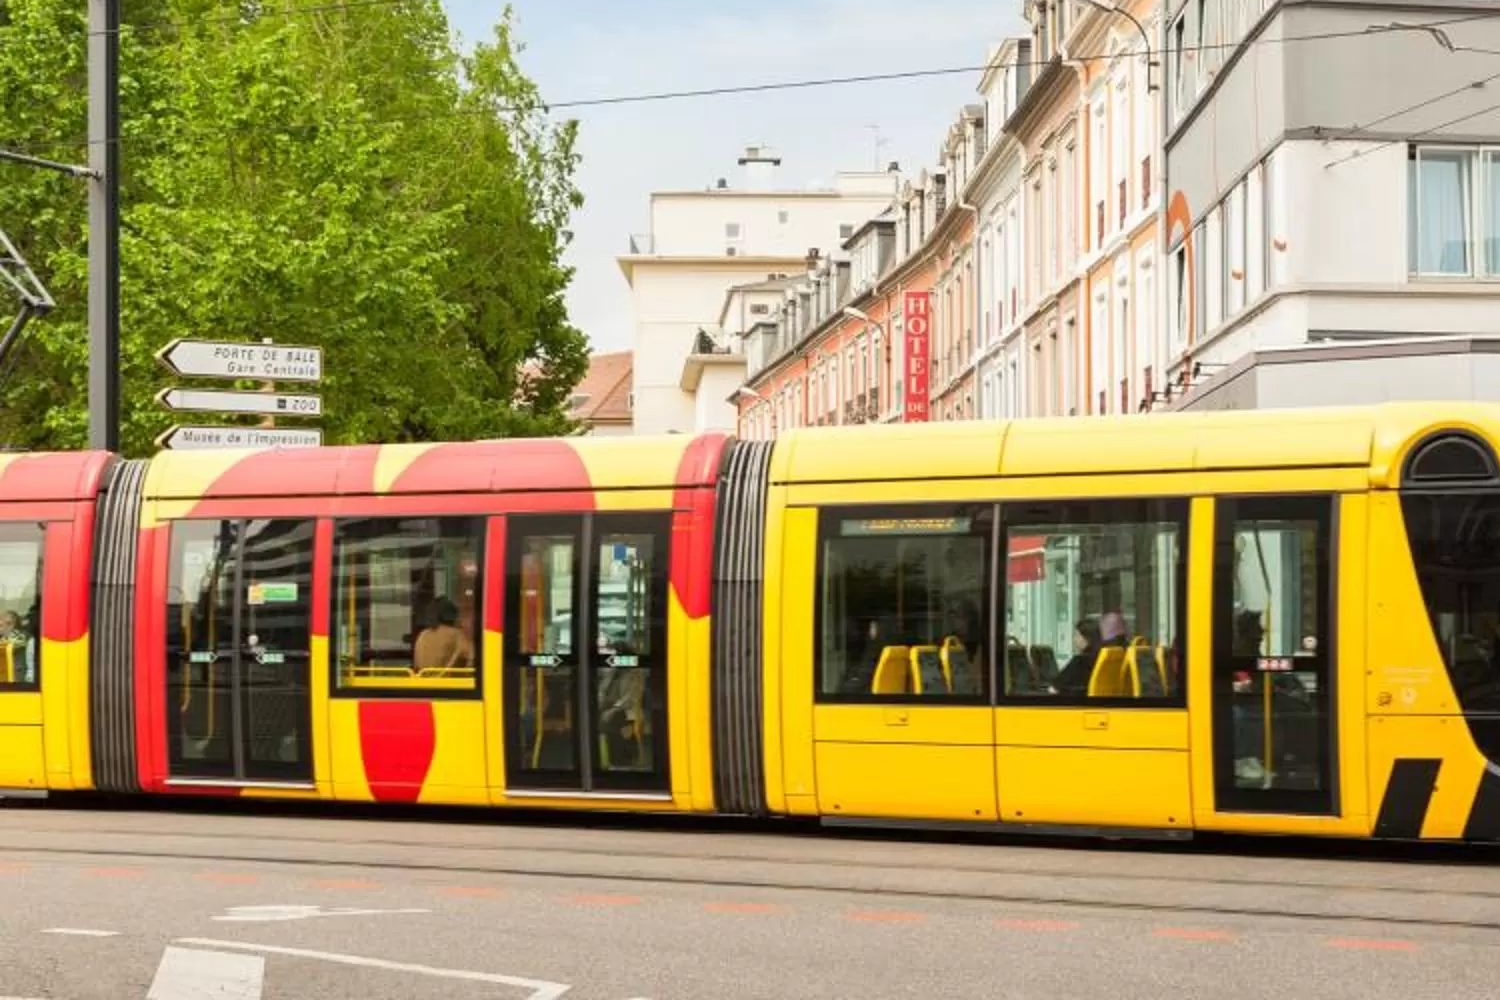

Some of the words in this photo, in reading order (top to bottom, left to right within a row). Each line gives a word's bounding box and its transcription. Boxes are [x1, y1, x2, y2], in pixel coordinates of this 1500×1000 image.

[907, 297, 926, 394] HOTEL
[213, 347, 254, 361] PORTE
[262, 349, 277, 362] DE
[227, 362, 255, 374] Gare
[264, 363, 318, 377] Centrale
[292, 399, 317, 411] ZOO
[907, 402, 926, 413] DE
[182, 430, 220, 443] Musée
[227, 432, 241, 444] de
